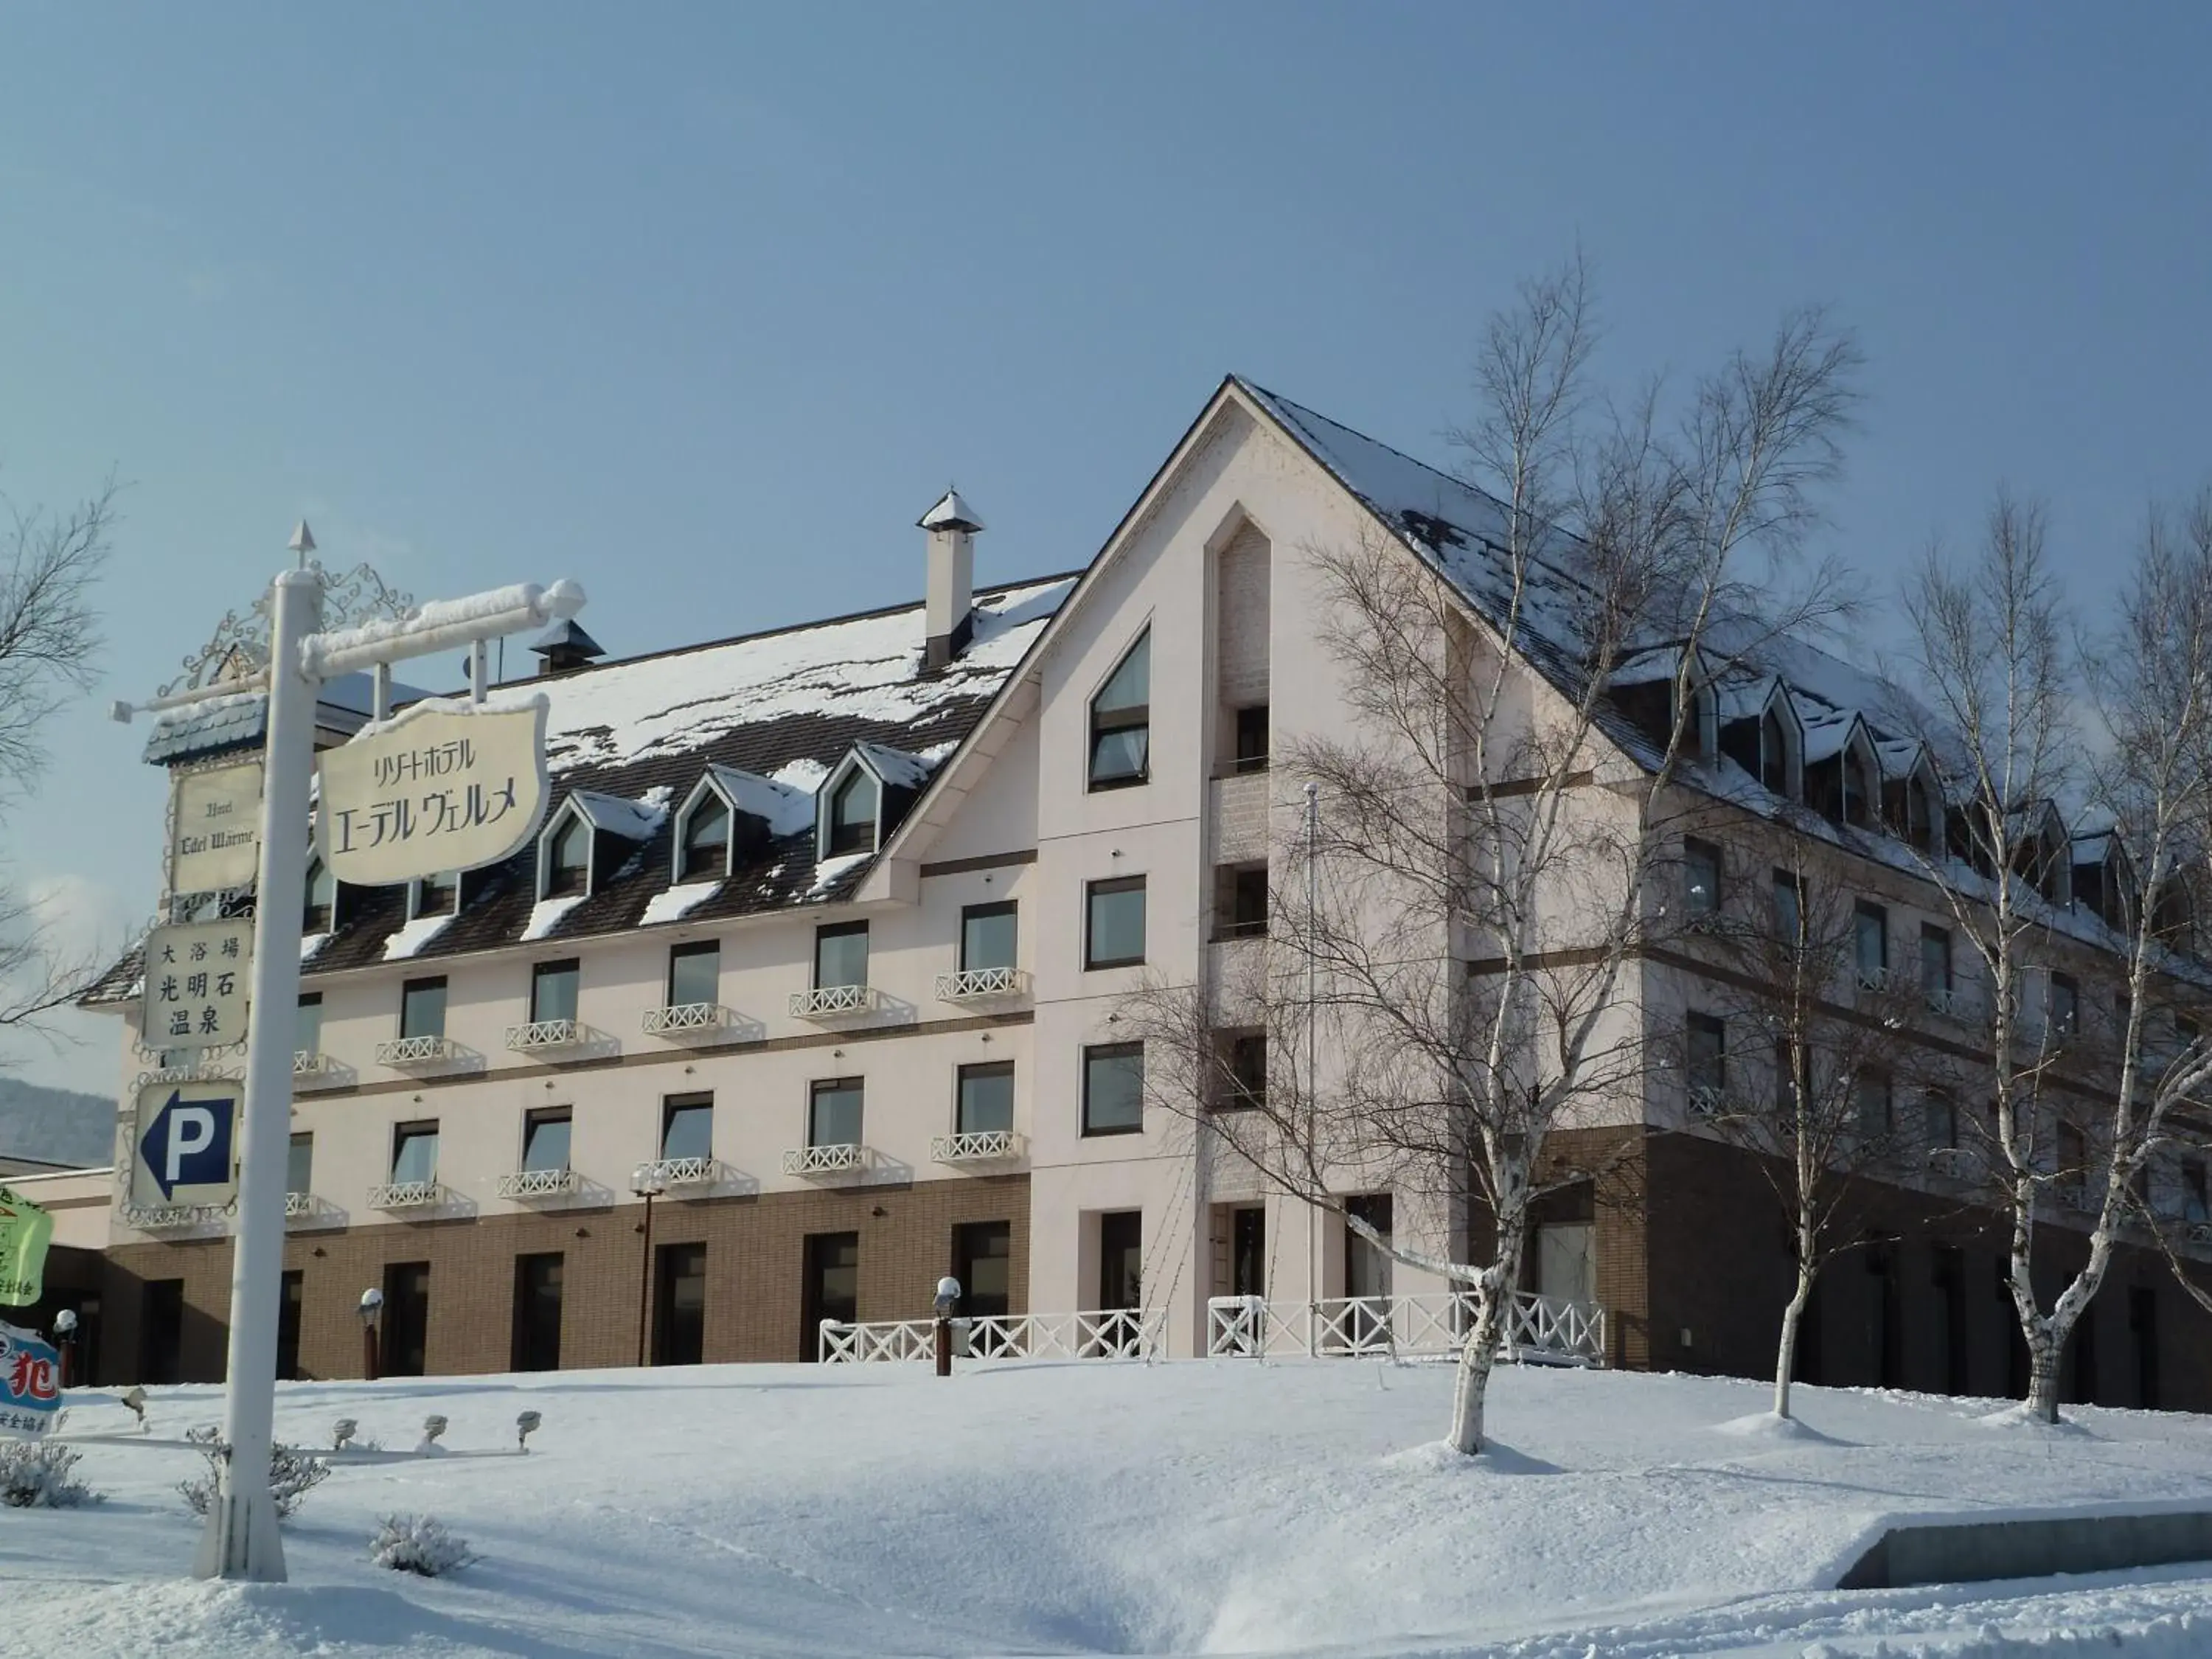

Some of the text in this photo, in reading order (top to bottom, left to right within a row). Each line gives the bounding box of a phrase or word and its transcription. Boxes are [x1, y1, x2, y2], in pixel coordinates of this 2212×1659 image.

[161, 936, 240, 964] 大浴場
[159, 971, 236, 1002] 光明石
[170, 1005, 220, 1035] 温泉
[165, 1107, 215, 1180] P
[8, 1352, 58, 1398] 犯
